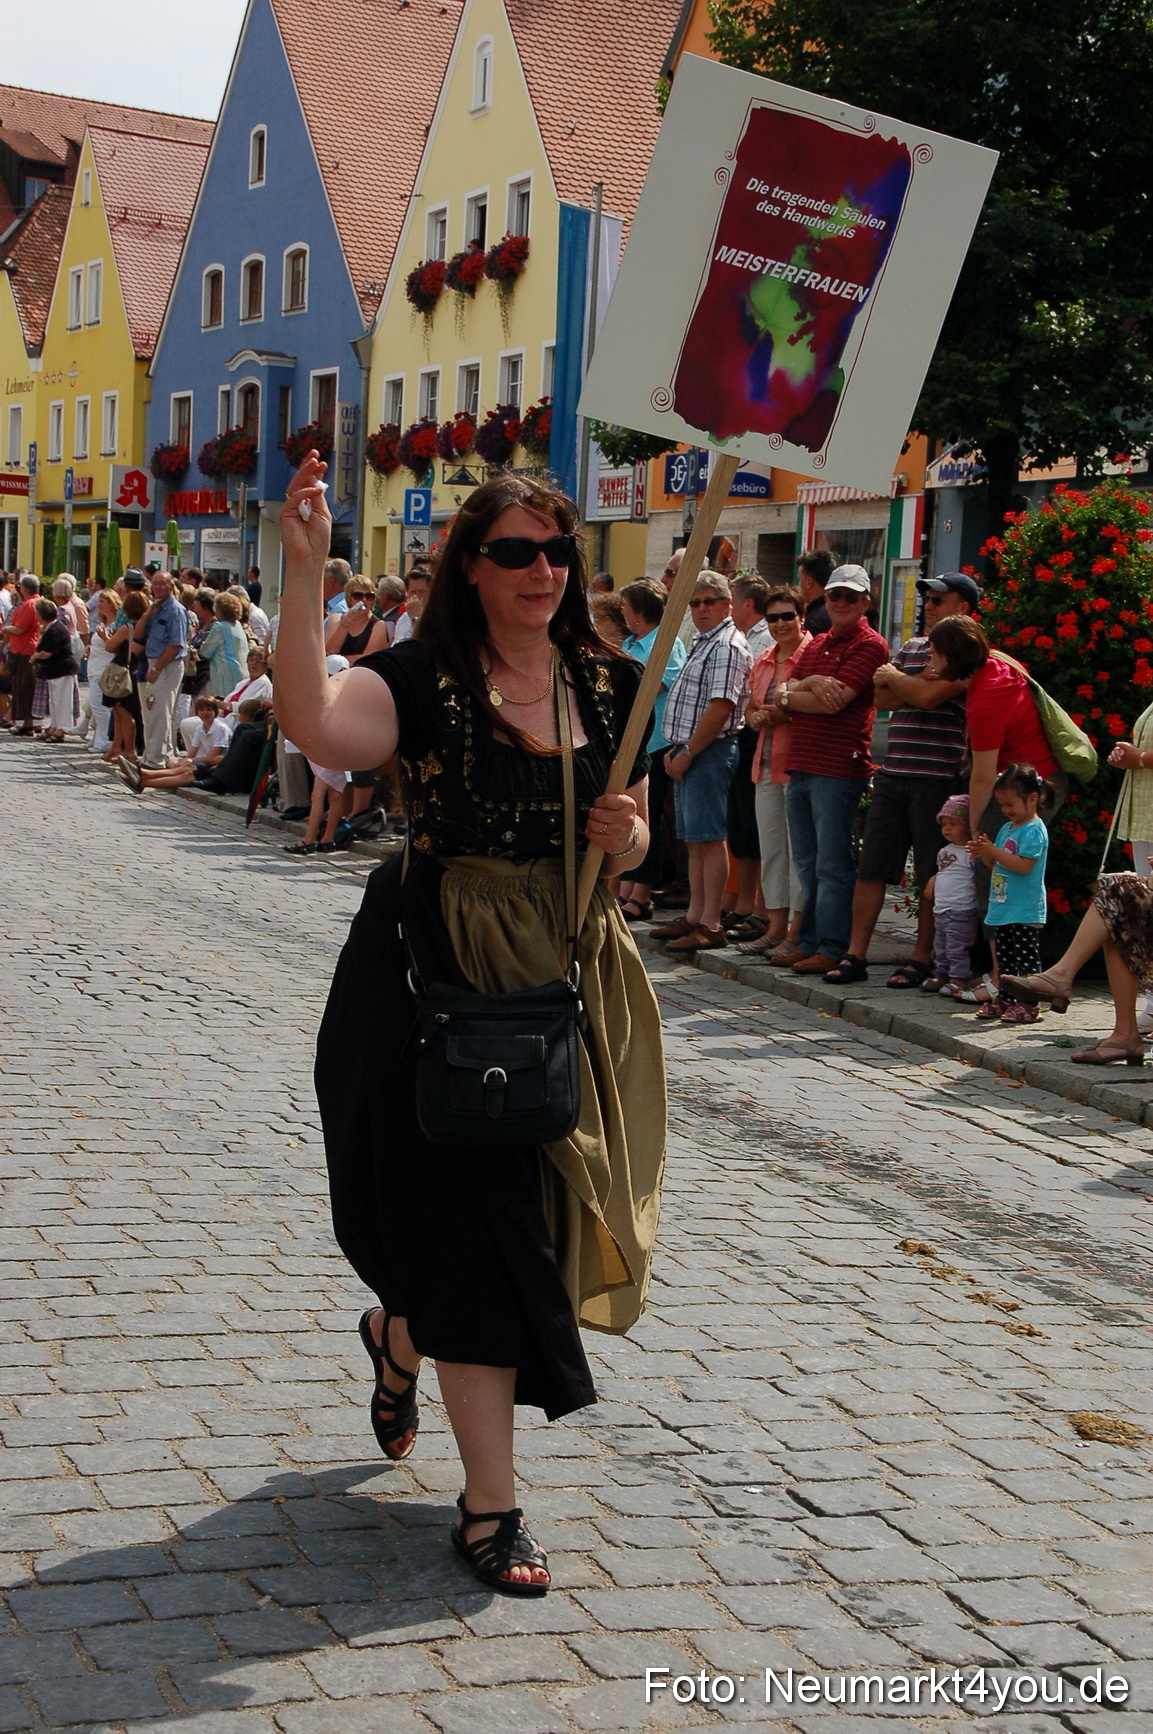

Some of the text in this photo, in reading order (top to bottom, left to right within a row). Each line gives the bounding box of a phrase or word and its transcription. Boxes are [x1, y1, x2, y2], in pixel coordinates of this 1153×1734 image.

[746, 177, 887, 230] Die tragenden Säulen
[755, 200, 856, 239] des Handwerks
[714, 245, 870, 303] MEISTERFRAUEN
[410, 493, 426, 522] P
